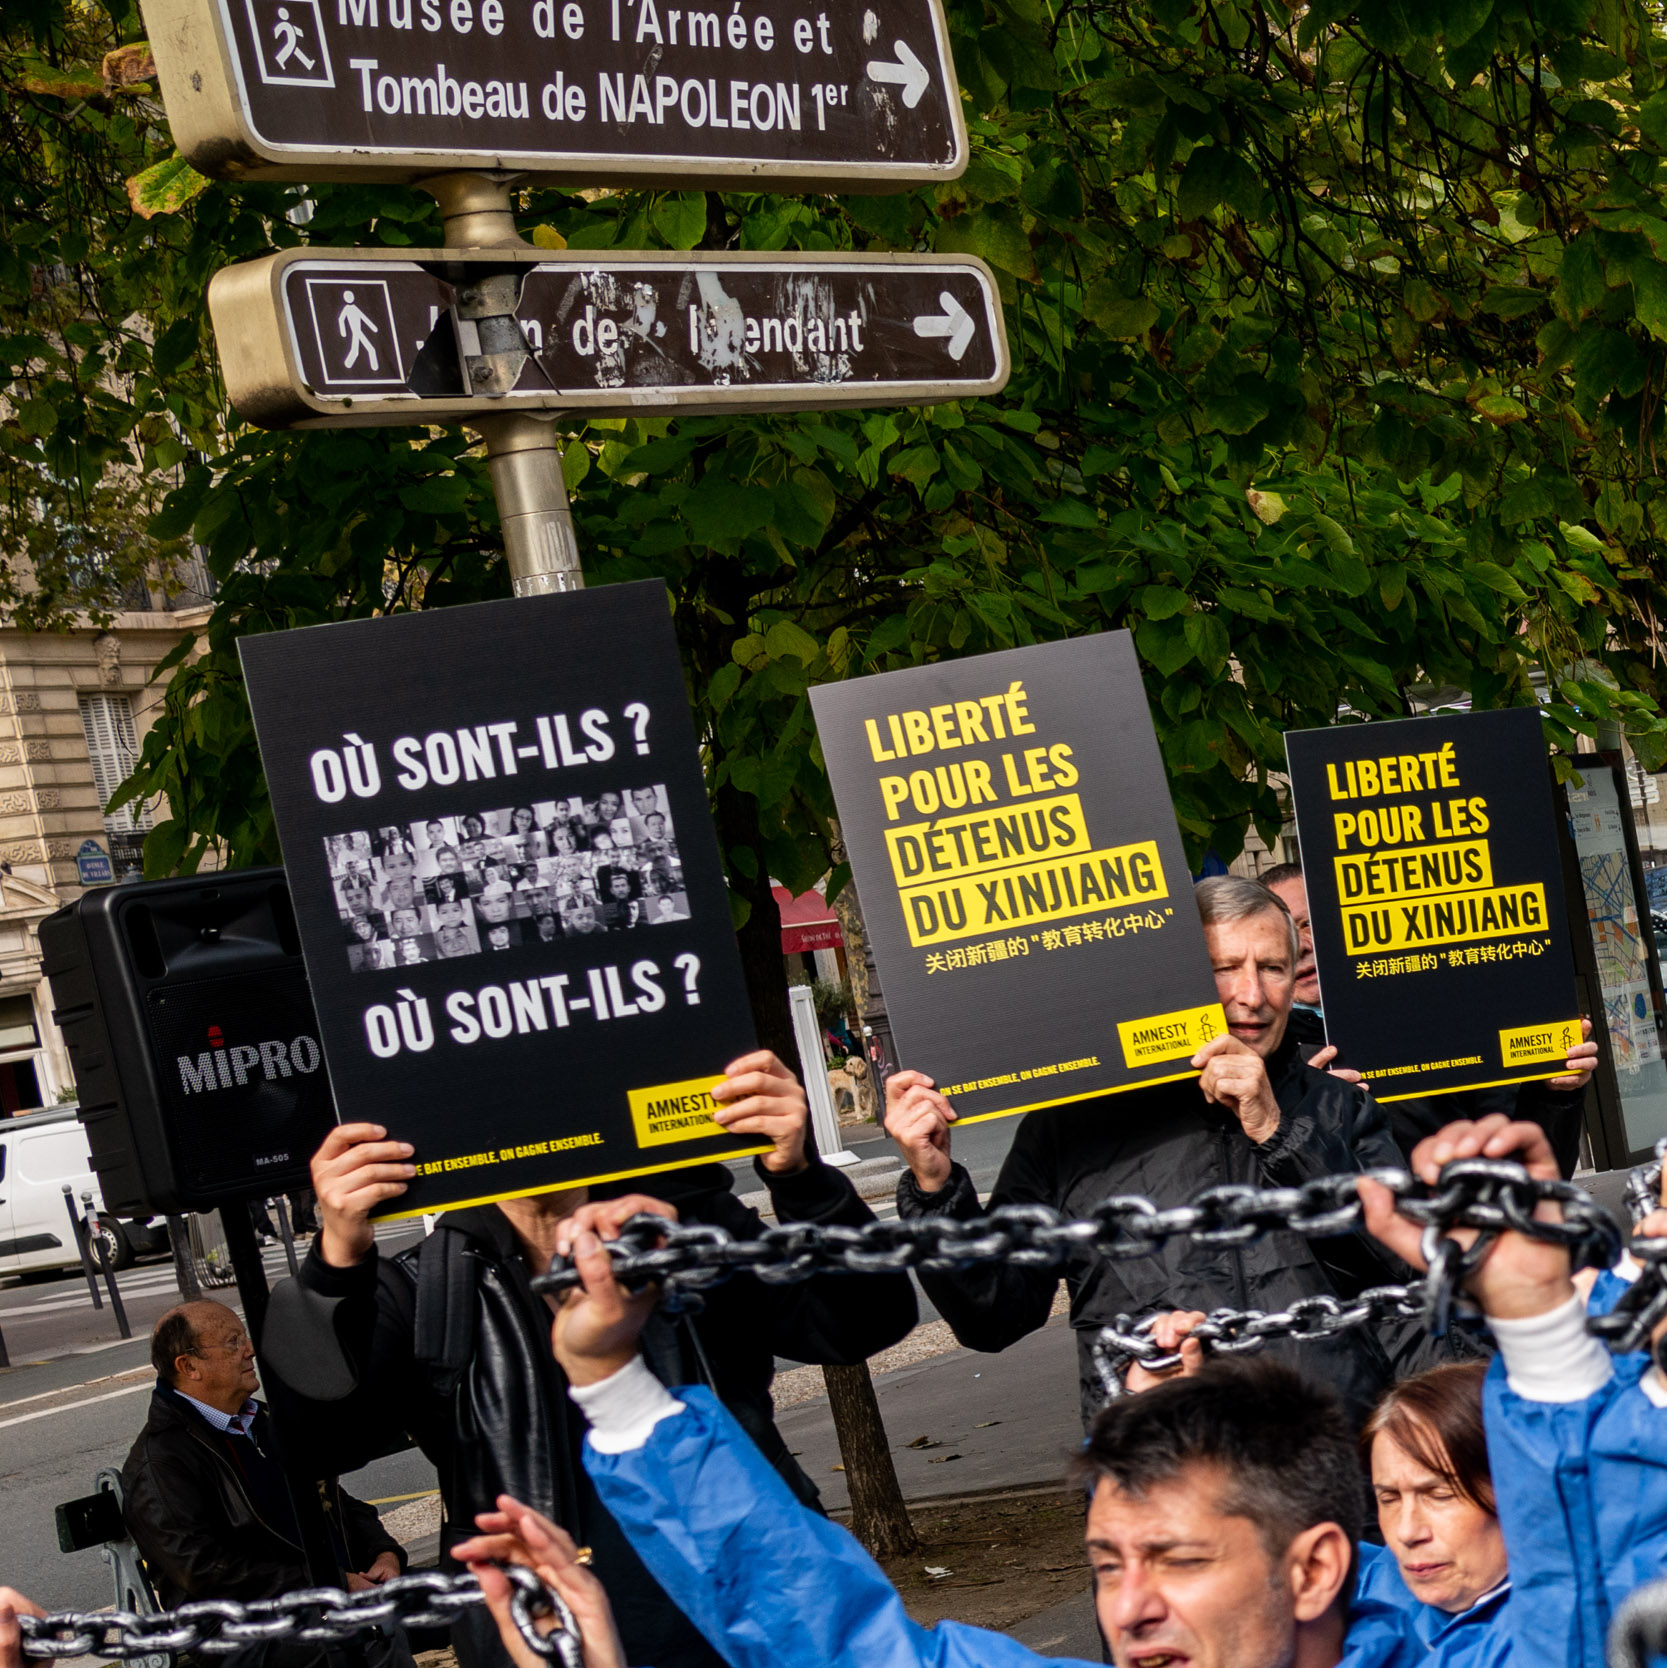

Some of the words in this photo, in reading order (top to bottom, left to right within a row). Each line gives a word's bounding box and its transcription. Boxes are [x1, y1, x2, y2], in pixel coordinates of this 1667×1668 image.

[532, 0, 585, 39] de
[612, 0, 775, 52] l'Armée
[794, 12, 834, 54] et
[350, 59, 530, 119] Tombeau
[542, 71, 586, 122] de
[598, 72, 800, 131] NAPOLEON
[811, 82, 849, 131] 1er
[572, 304, 620, 356] de
[864, 680, 1036, 763] LIBERTÉ
[309, 734, 381, 803] OÙ
[393, 709, 616, 792] SONT-ILS
[623, 702, 651, 755] ?
[1326, 742, 1460, 800] LIBERTÉ
[879, 760, 998, 820] POUR
[1001, 743, 1079, 798] LES
[898, 805, 1077, 879] DÉTENUS
[1333, 805, 1426, 850] POUR
[1432, 796, 1490, 839] LES
[907, 888, 967, 938] DU
[983, 852, 1157, 924] XINJIANG
[1341, 847, 1483, 900] DÉTENUS
[1348, 909, 1393, 949] DU
[1404, 891, 1542, 942] XINJIANG
[364, 989, 435, 1058] OÙ
[448, 960, 666, 1045] SONT-ILS
[673, 953, 702, 1005] ?
[1132, 1022, 1188, 1048] AMNESTY
[1134, 1036, 1192, 1058] INTERNATIONAL
[1509, 1032, 1553, 1050] AMNESTY
[1510, 1045, 1555, 1059] INTERNATIONAL
[952, 1085, 963, 1095] SE
[1020, 1070, 1033, 1081] ON
[1033, 1064, 1059, 1078] GAGNE
[649, 1114, 714, 1133] INTERNATION
[255, 1153, 290, 1166] MA-505
[424, 1160, 443, 1175] BAT
[444, 1151, 500, 1171] ENSEMBLE,
[499, 1148, 515, 1162] ON
[516, 1142, 549, 1159] GAGNE
[550, 1132, 605, 1152] ENSEMBLE.
